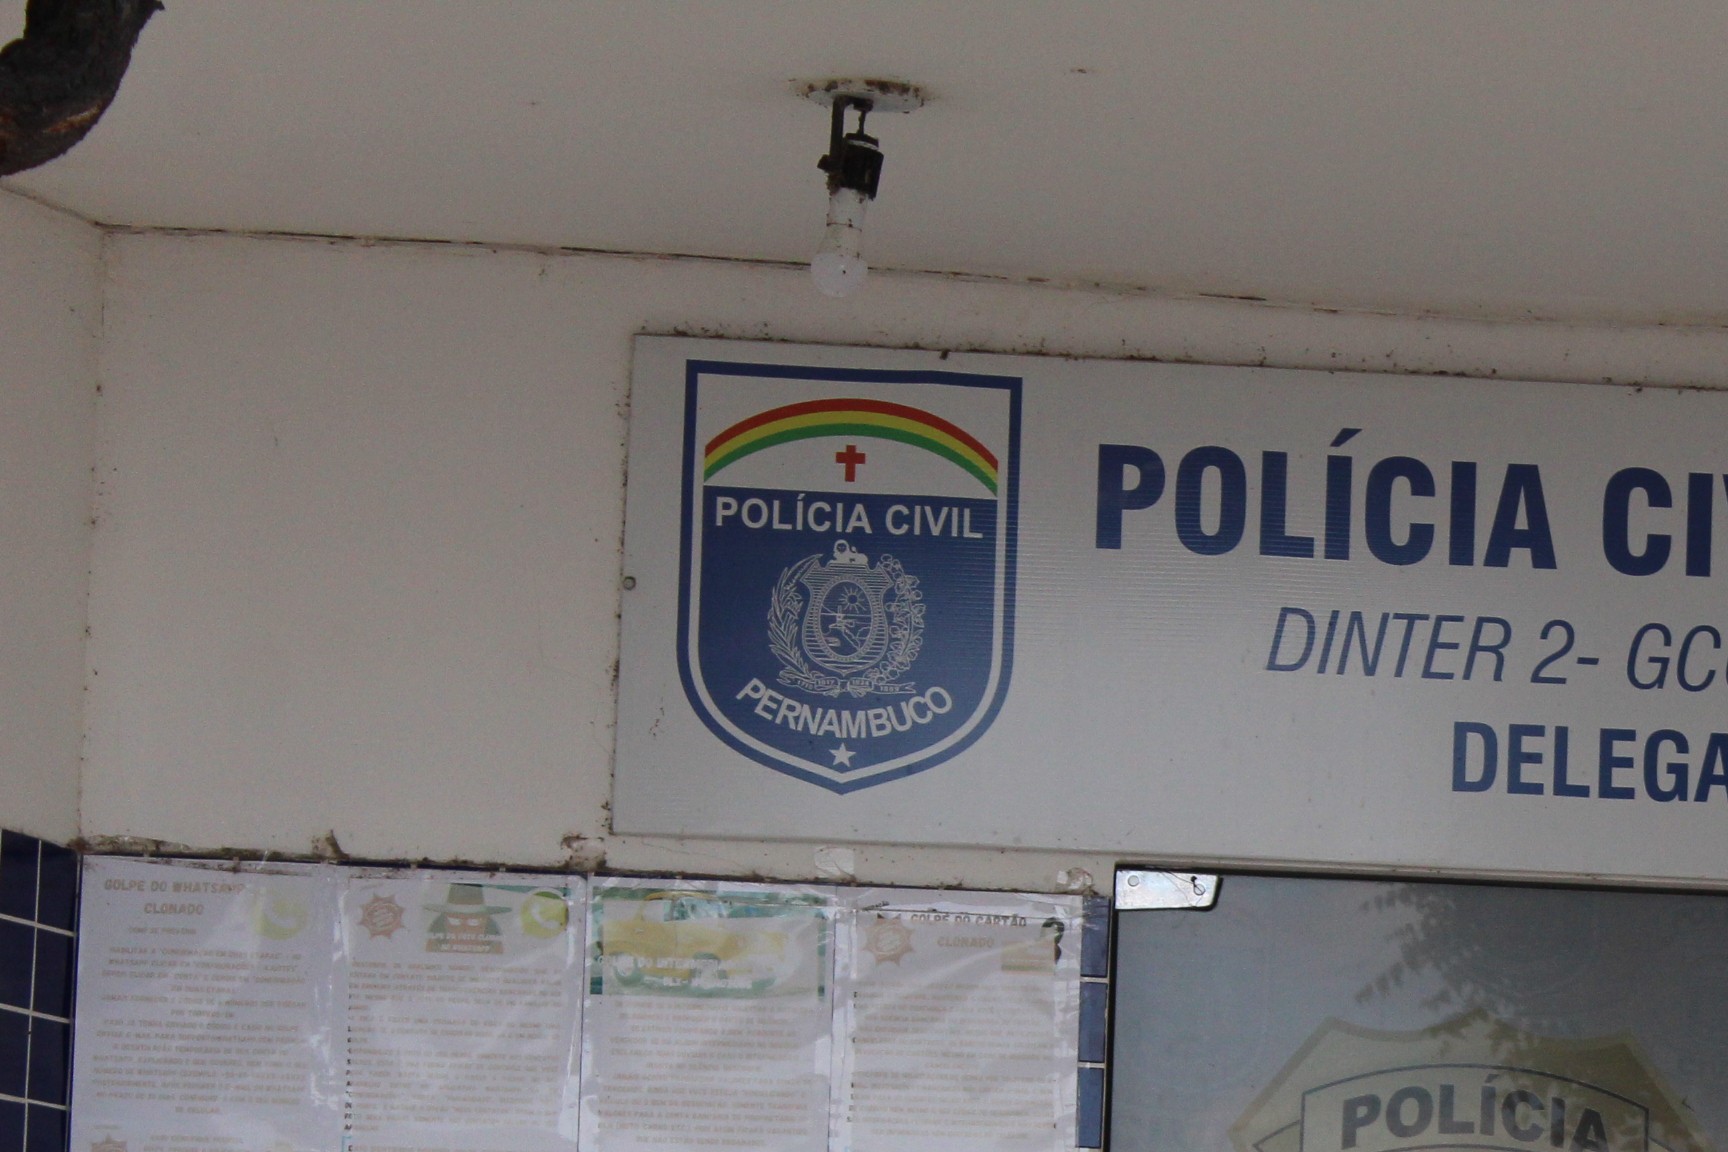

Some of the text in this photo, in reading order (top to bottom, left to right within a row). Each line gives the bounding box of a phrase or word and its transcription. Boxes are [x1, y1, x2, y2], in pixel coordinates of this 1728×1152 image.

[716, 494, 983, 538] POLÍCIA CIVIL
[1096, 428, 1557, 569] POLÍCIA
[1266, 607, 1512, 682] DINTER
[1531, 620, 1599, 684] 2-
[735, 677, 953, 739] PERNAMBUCO
